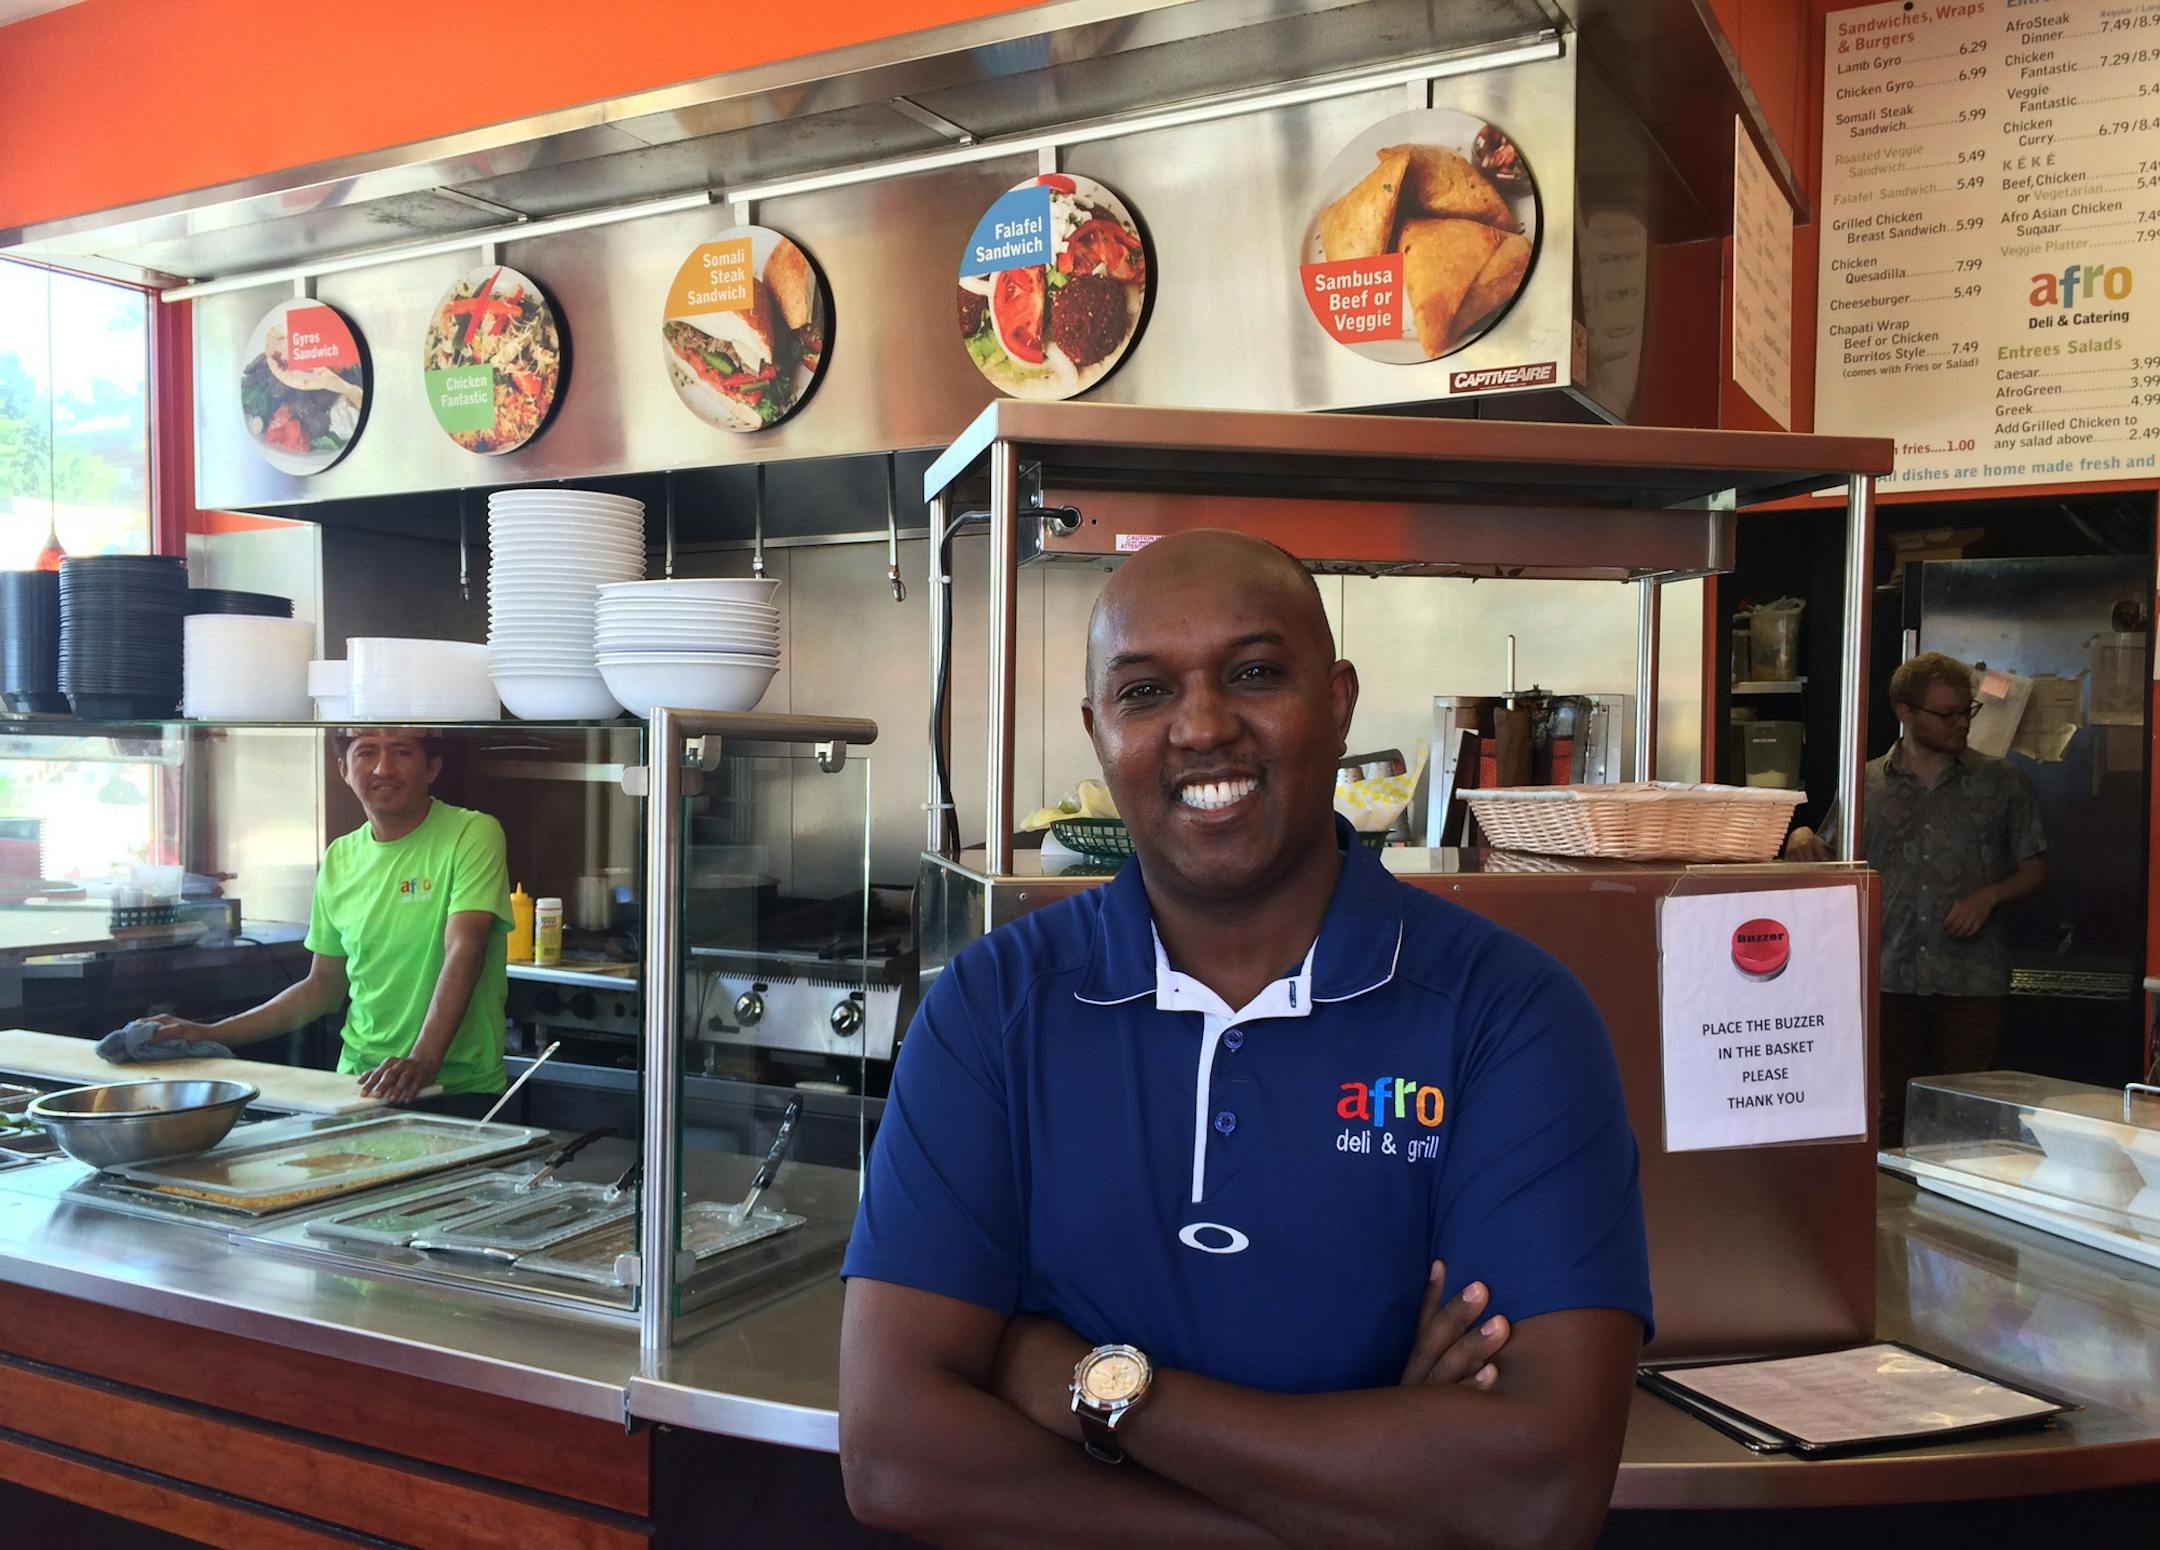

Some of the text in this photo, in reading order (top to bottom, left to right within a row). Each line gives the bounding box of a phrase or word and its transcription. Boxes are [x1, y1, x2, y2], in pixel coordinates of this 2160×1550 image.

[1838, 3, 1986, 36] Sandwiches, Wraps
[2006, 13, 2070, 33] AfroSteak
[1838, 31, 1914, 54] & Burgers
[2021, 31, 2064, 45] Dinner
[1837, 40, 1987, 75] Lamb Gyro 6.29
[2005, 50, 2054, 67] Chicken
[2020, 61, 2079, 79] Fantastic
[1836, 66, 1987, 100] Chicken Gyro 6.99
[2007, 85, 2049, 100] Veggie
[2020, 82, 2160, 113] Fantastic 5.4
[1836, 104, 1914, 125] Somali Steak
[1850, 107, 1986, 138] Sandwich 5.99
[2003, 117, 2053, 134] Chicken
[2019, 134, 2054, 147] Curry
[1835, 144, 1924, 165] Roasted Veggie
[1849, 149, 1986, 178] Sandwich 5.49
[2139, 160, 2160, 173] 7.4
[1833, 176, 1984, 205] Falafel Sandwich 5.49
[2017, 176, 2160, 203] or Vegetarian 5.4
[1832, 211, 1922, 231] Grilled Chicken
[2001, 201, 2122, 223] Afro Asian Chicken
[995, 216, 1042, 240] Falafel
[1847, 217, 1984, 244] Breast Sandwich 5.99
[2017, 224, 2061, 237] Suqaar
[703, 249, 745, 268] Somali
[976, 237, 1043, 263] Sandwich
[2001, 243, 2042, 258] Veggie
[2045, 239, 2088, 252] Platter
[1831, 257, 1877, 271] Chicken
[1845, 258, 1982, 285] Quesadilla 7.99
[710, 267, 745, 285] Steak
[1315, 269, 1393, 292] Sambusa
[2029, 264, 2133, 309] afro
[688, 285, 746, 306] Sandwich
[1329, 291, 1393, 311] Beef or
[1830, 284, 1981, 311] Cheeseburger 5.49
[1334, 311, 1392, 333] Veggie
[1829, 319, 1910, 336] Chapati Wrap
[2028, 310, 2130, 329] Deli & Catering
[292, 331, 320, 347] Gyros
[1844, 331, 1939, 350] Beef or Chicken
[1998, 337, 2122, 361] Entrees Salads
[293, 344, 339, 362] Sandwich
[1843, 341, 1979, 365] Burritos Style 7.49
[1454, 365, 1553, 389] CAPTIVEAIRE
[1843, 358, 1979, 378] (comes with Fries or Salad)
[1996, 356, 2160, 381] Caesar 3.99
[446, 375, 487, 391] Chicken
[1996, 374, 2160, 399] AfroGreen 3.99
[441, 391, 488, 408] Fantastic
[1995, 393, 2160, 416] Greek 4.99
[1995, 415, 2138, 434] Add Grilled Chicken to
[1902, 443, 1930, 455] fries
[1947, 439, 1975, 452] 1.00
[1994, 427, 2160, 450] any salad above 2.49
[1902, 467, 1949, 481] dishes
[1954, 467, 1978, 479] are
[1983, 463, 2026, 477] home
[2032, 460, 2074, 474] made
[2080, 456, 2120, 471] fresh
[2126, 454, 2155, 469] and
[1737, 932, 1784, 944] Buzzer
[1702, 1014, 1825, 1036] PLACE THE BUZZER
[1718, 1040, 1814, 1060] IN THE BASKET
[1742, 1068, 1789, 1083] PLEASE
[1337, 1076, 1445, 1128] afro
[1727, 1091, 1805, 1109] THANK YOU
[1336, 1128, 1440, 1163] deli & grill
